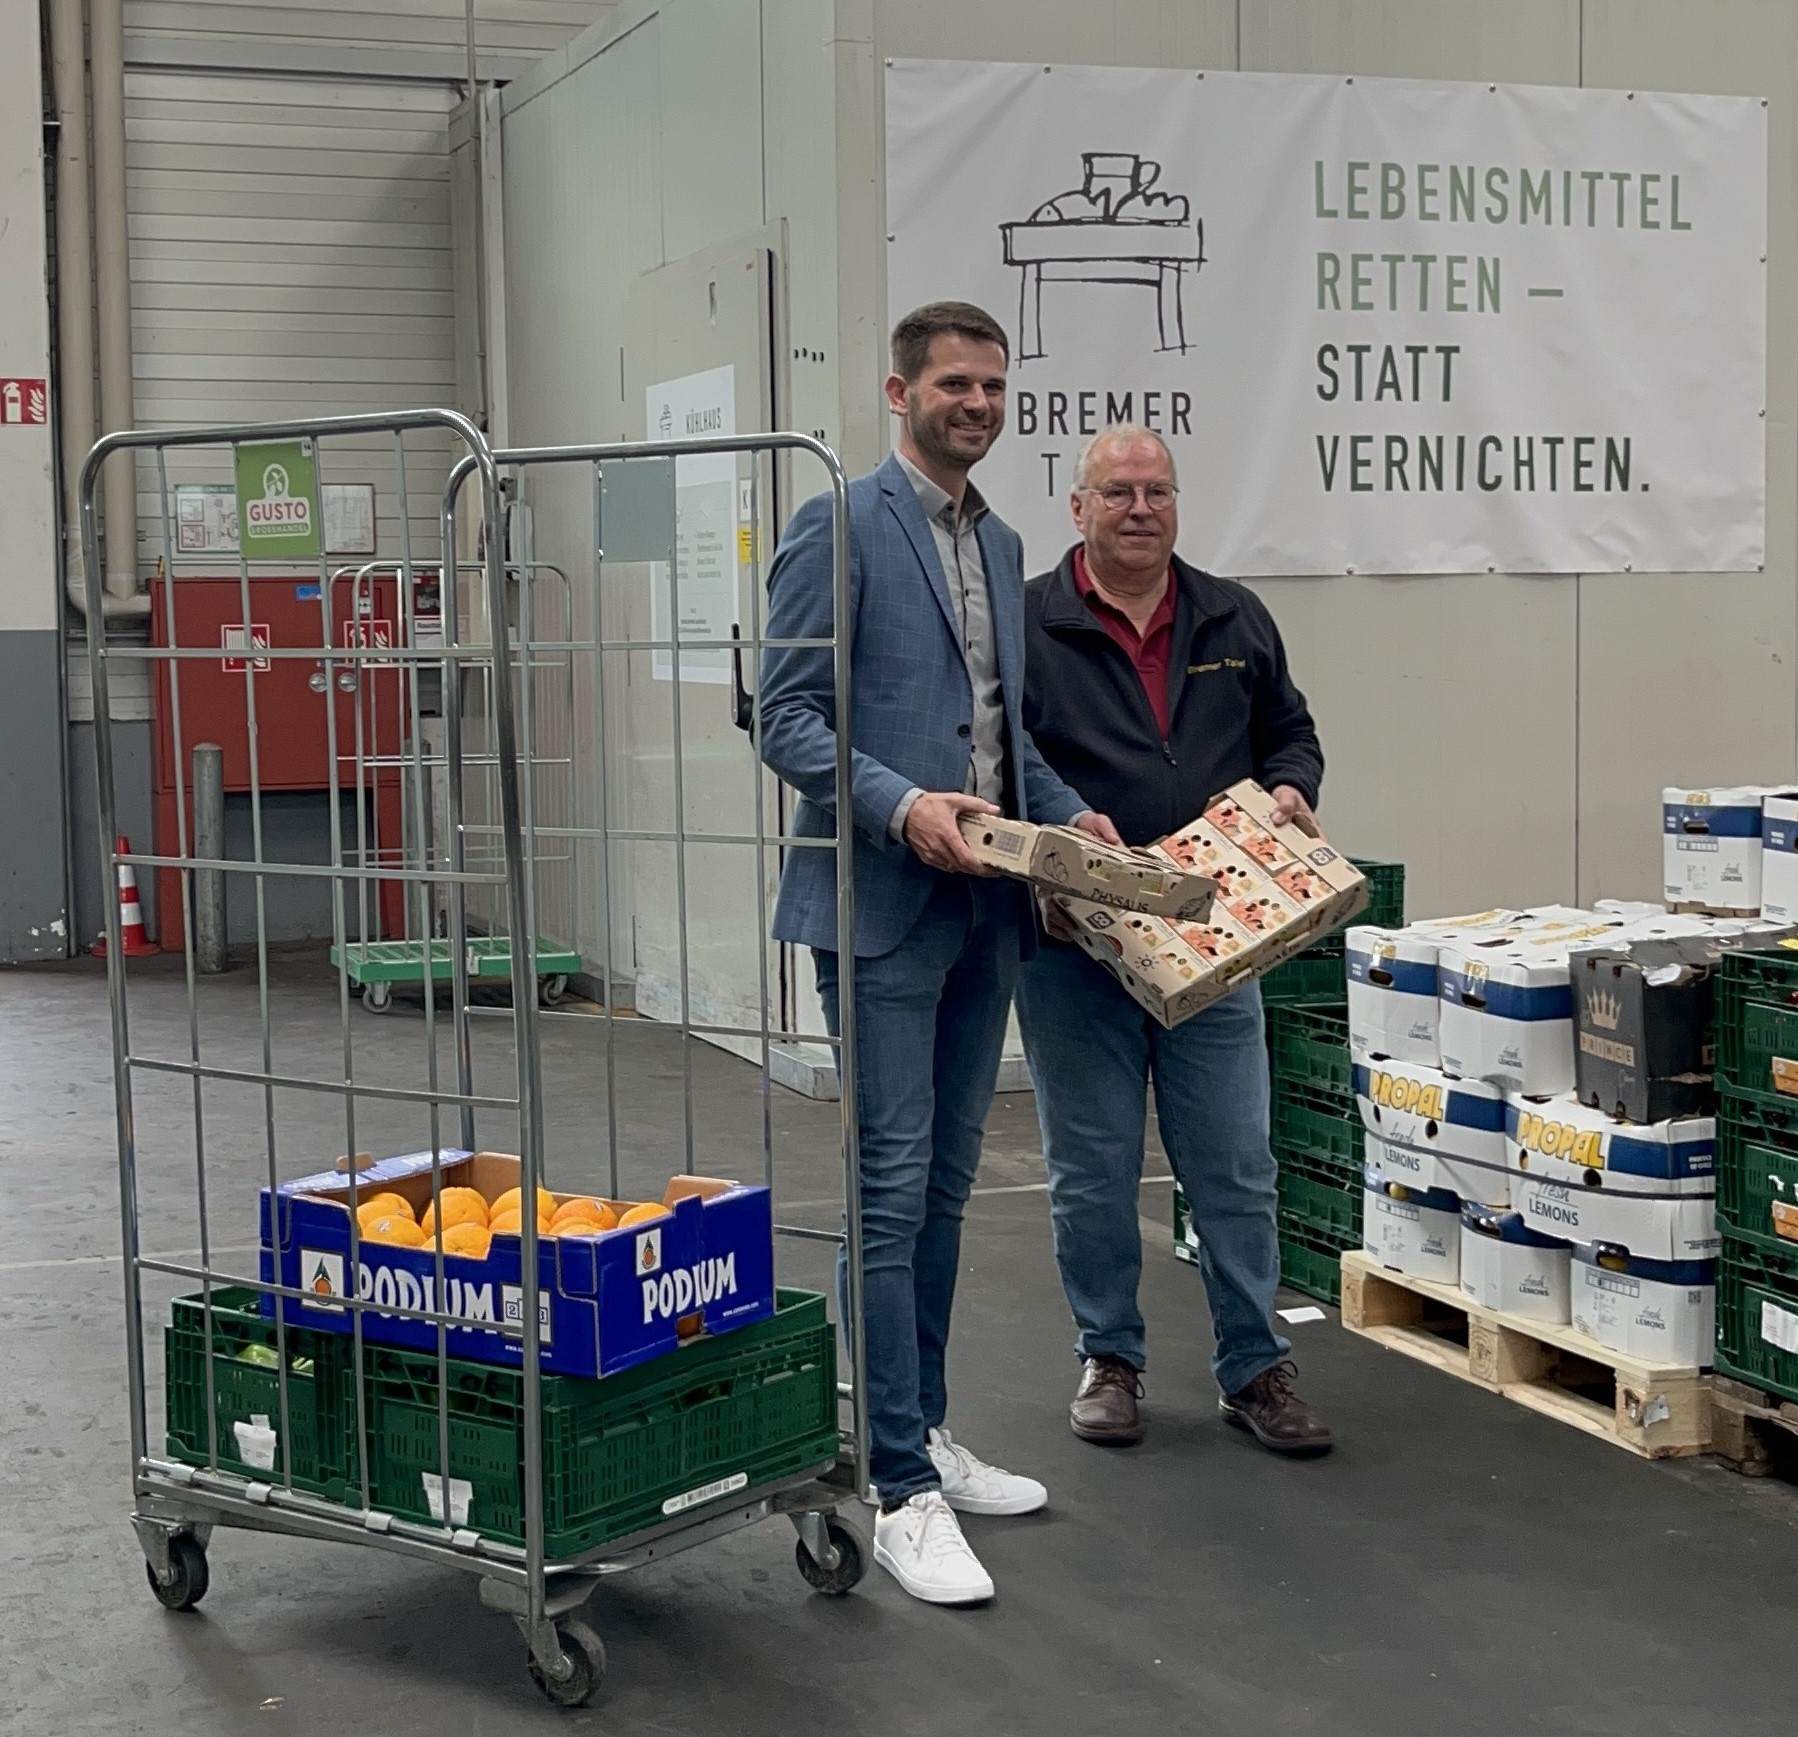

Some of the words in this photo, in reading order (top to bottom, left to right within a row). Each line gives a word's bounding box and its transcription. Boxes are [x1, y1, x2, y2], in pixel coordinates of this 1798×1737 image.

[1314, 160, 1692, 231] LEBENSMITTEL
[1316, 251, 1501, 314] RETTEN
[1316, 343, 1461, 402] STATT
[1017, 391, 1192, 436] BREMER
[1316, 434, 1650, 493] VERNICHTEN.
[249, 501, 307, 522] GUSTO
[1369, 1069, 1444, 1122] PROPAL
[1384, 1145, 1421, 1173] LEMONS
[1517, 1110, 1605, 1171] PROPAL
[1528, 1198, 1580, 1227] LEMONS
[351, 1261, 498, 1335] PODIUM
[642, 1251, 738, 1325] PODIUM
[1635, 1317, 1666, 1331] LEMONS
